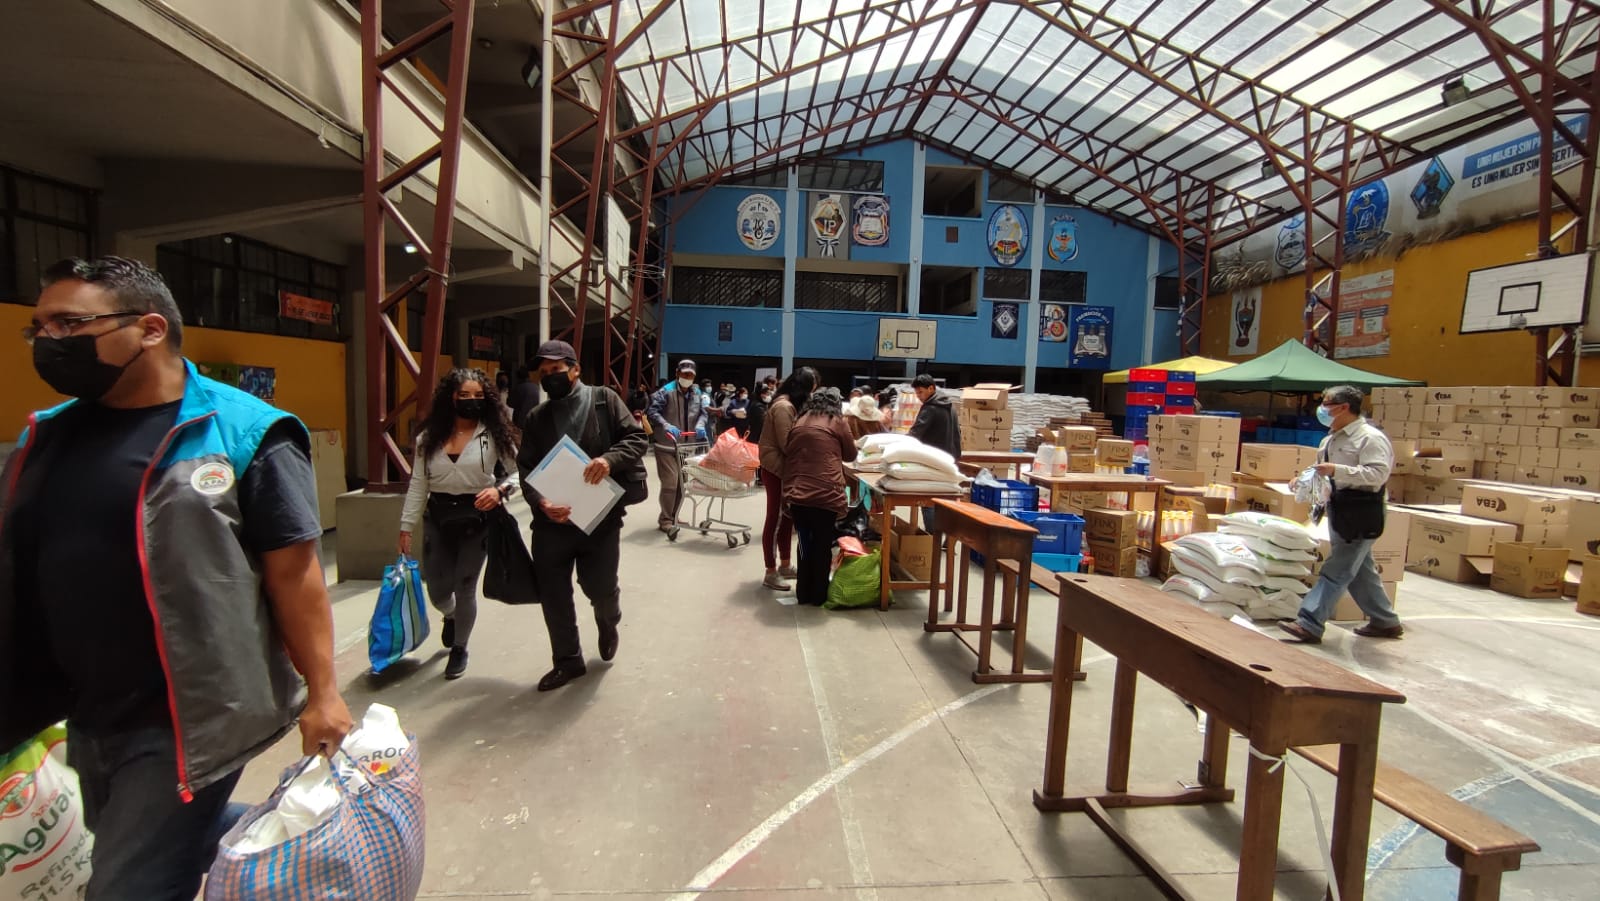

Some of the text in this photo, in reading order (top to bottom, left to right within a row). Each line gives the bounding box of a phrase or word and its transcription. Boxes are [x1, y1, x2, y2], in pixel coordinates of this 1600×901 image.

[1491, 145, 1518, 163] MUJER
[1518, 140, 1533, 154] SIN
[1472, 177, 1482, 189] ES
[1499, 162, 1526, 178] MUJER
[1526, 158, 1540, 171] SIN
[1476, 496, 1497, 509] EBA
